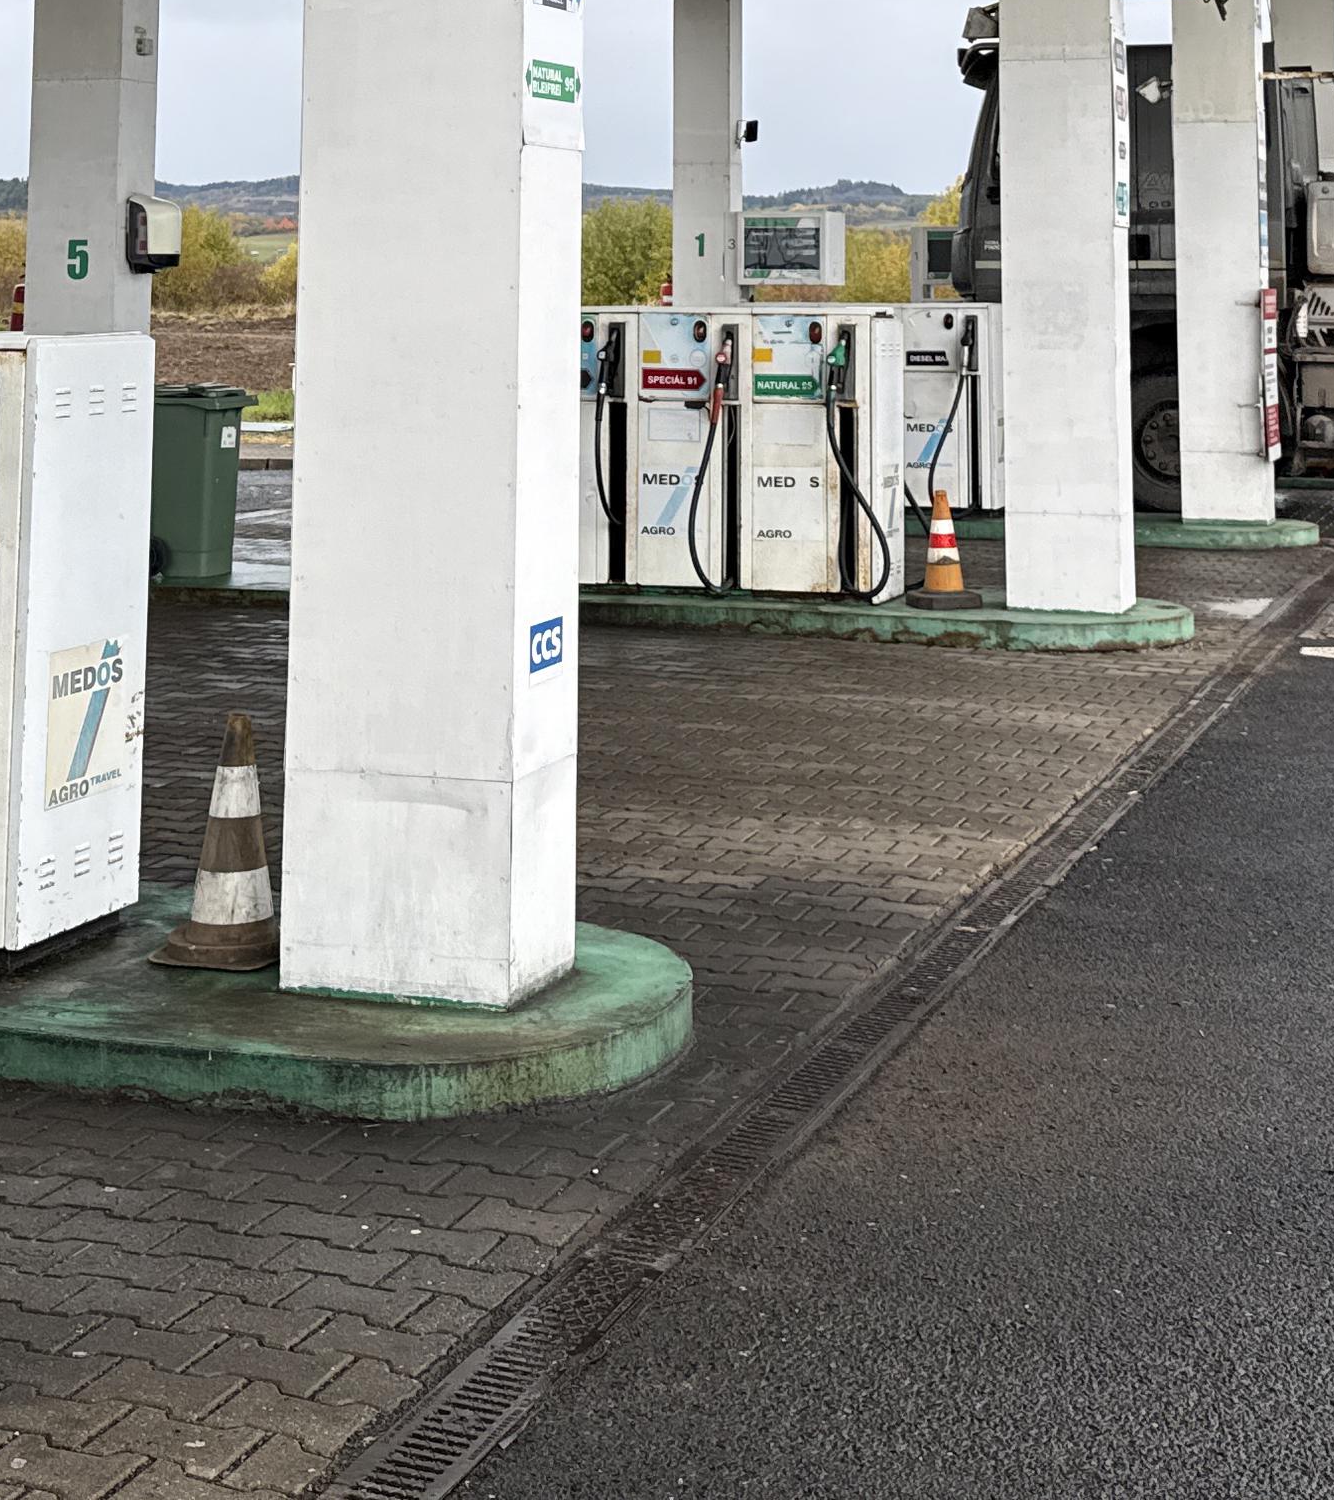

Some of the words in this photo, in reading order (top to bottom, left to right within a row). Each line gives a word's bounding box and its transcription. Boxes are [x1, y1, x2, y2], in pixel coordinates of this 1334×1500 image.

[532, 66, 563, 83] NATURAL
[564, 76, 574, 92] 95
[694, 233, 705, 257] 1
[727, 238, 736, 250] 3
[67, 239, 89, 280] 5
[687, 377, 698, 385] 91
[757, 381, 800, 390] NATURAL
[801, 381, 813, 390] 95
[641, 526, 676, 536] AGRO
[756, 529, 792, 539] AGRO
[531, 625, 562, 665] CCS
[52, 657, 123, 700] MEDOS
[48, 779, 90, 807] AGRO
[90, 768, 122, 787] TRAVEL
